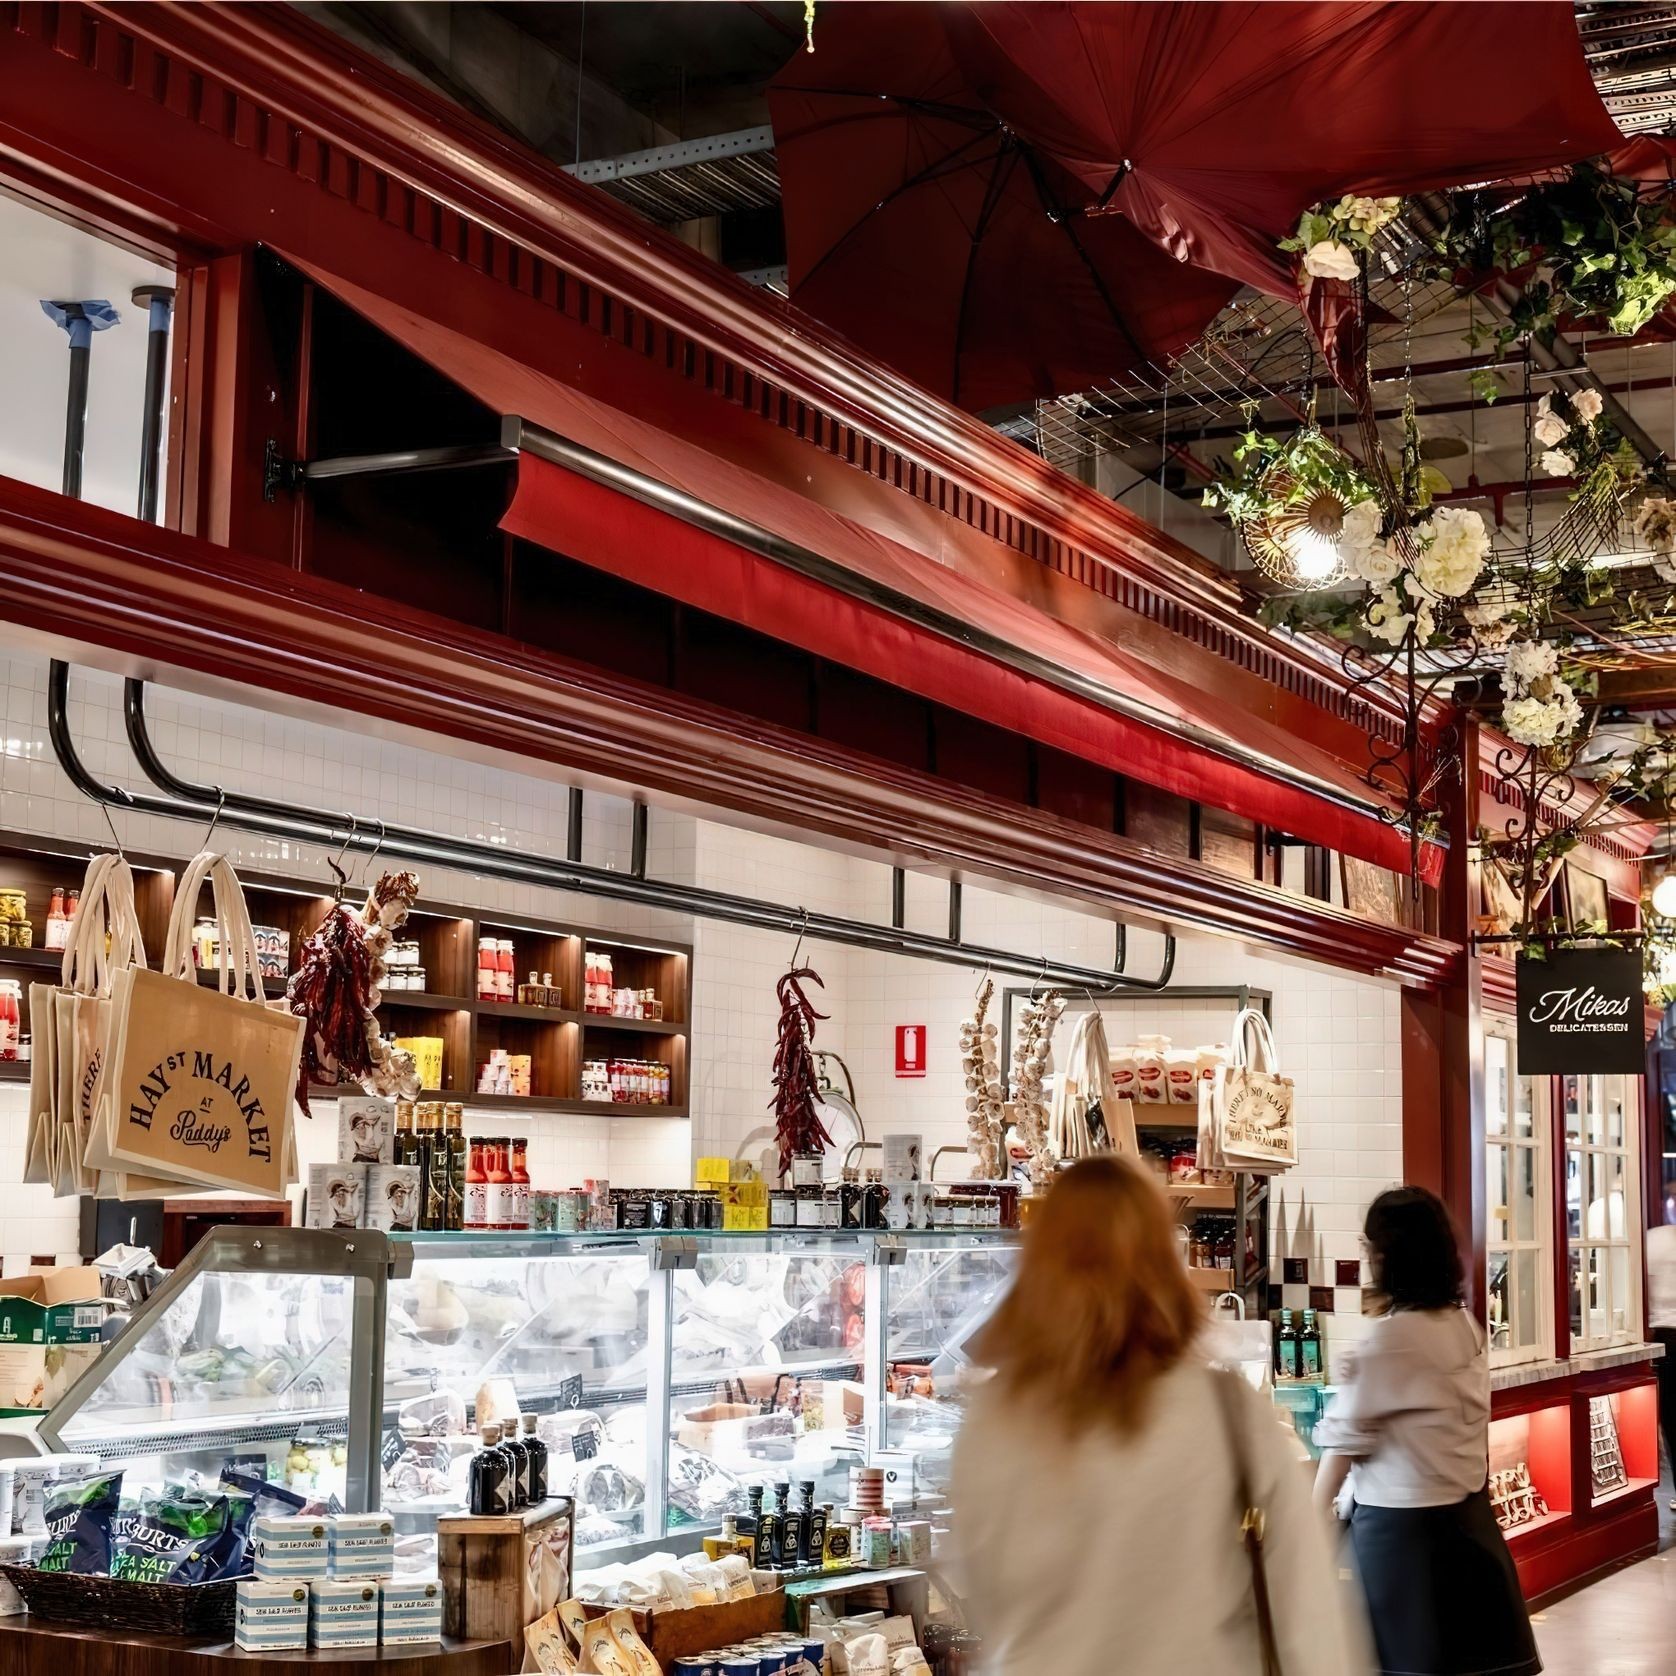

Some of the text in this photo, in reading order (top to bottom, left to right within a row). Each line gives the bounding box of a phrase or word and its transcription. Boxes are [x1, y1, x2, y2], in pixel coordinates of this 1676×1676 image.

[1529, 986, 1630, 1023] Mikas
[1549, 1023, 1629, 1033] DELICATESSEN
[129, 1051, 271, 1163] HAY ST MARKET
[200, 1096, 214, 1108] AT
[169, 1109, 231, 1154] Paddy's
[140, 1557, 177, 1573] SALT
